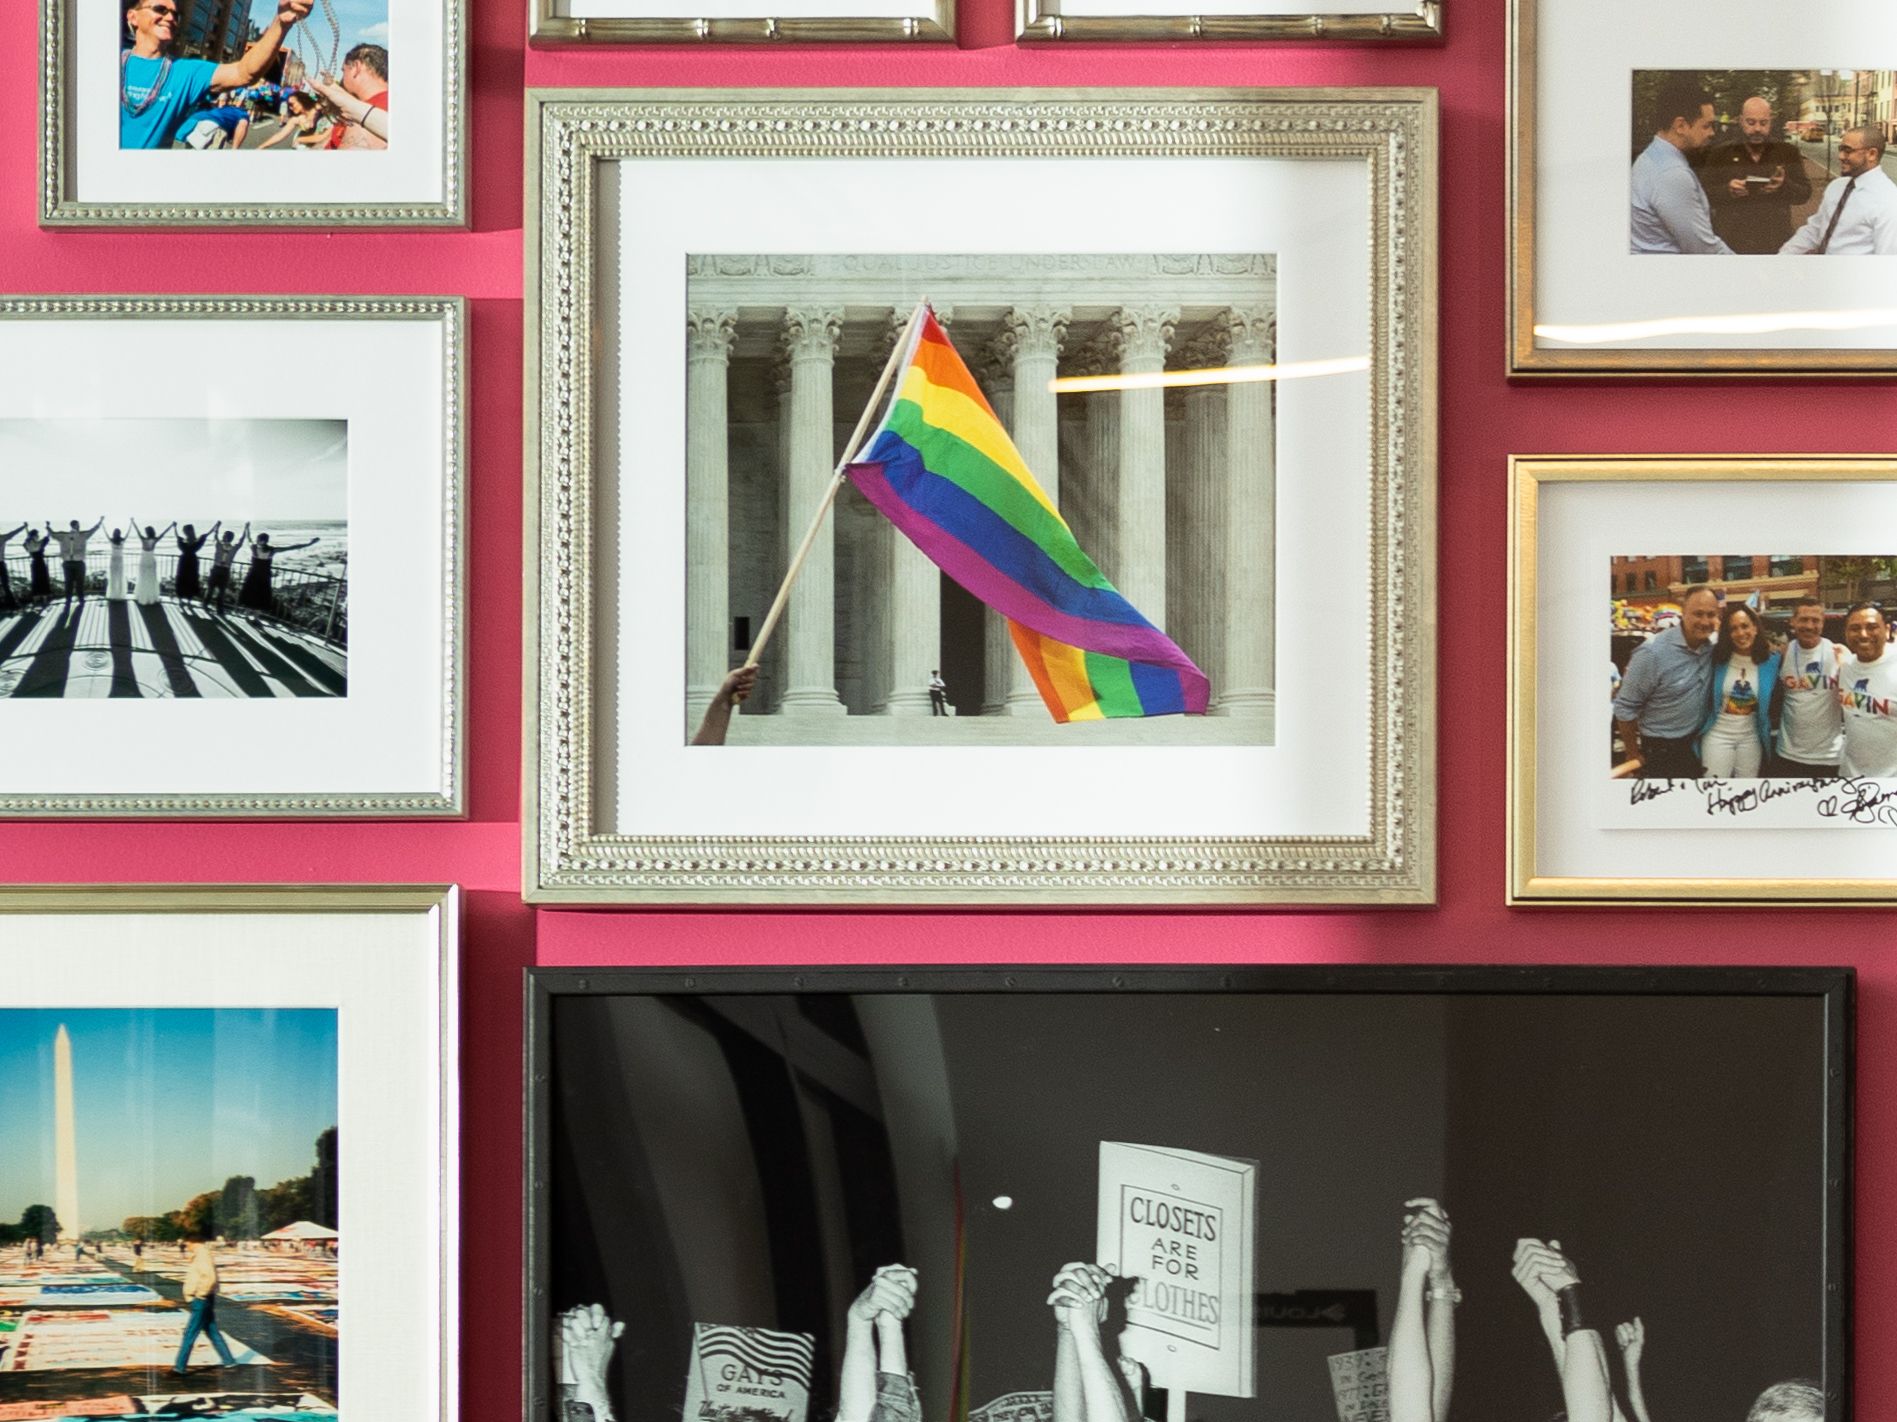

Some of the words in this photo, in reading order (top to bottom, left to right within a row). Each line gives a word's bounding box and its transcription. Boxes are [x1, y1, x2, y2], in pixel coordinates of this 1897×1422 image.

[1784, 674, 1840, 690] GAVIN
[1130, 1196, 1217, 1242] CLOSETS
[1152, 1237, 1198, 1261] ARE
[1152, 1254, 1199, 1281] FOR
[716, 1384, 731, 1393] OF
[736, 1386, 786, 1399] AMERICA
